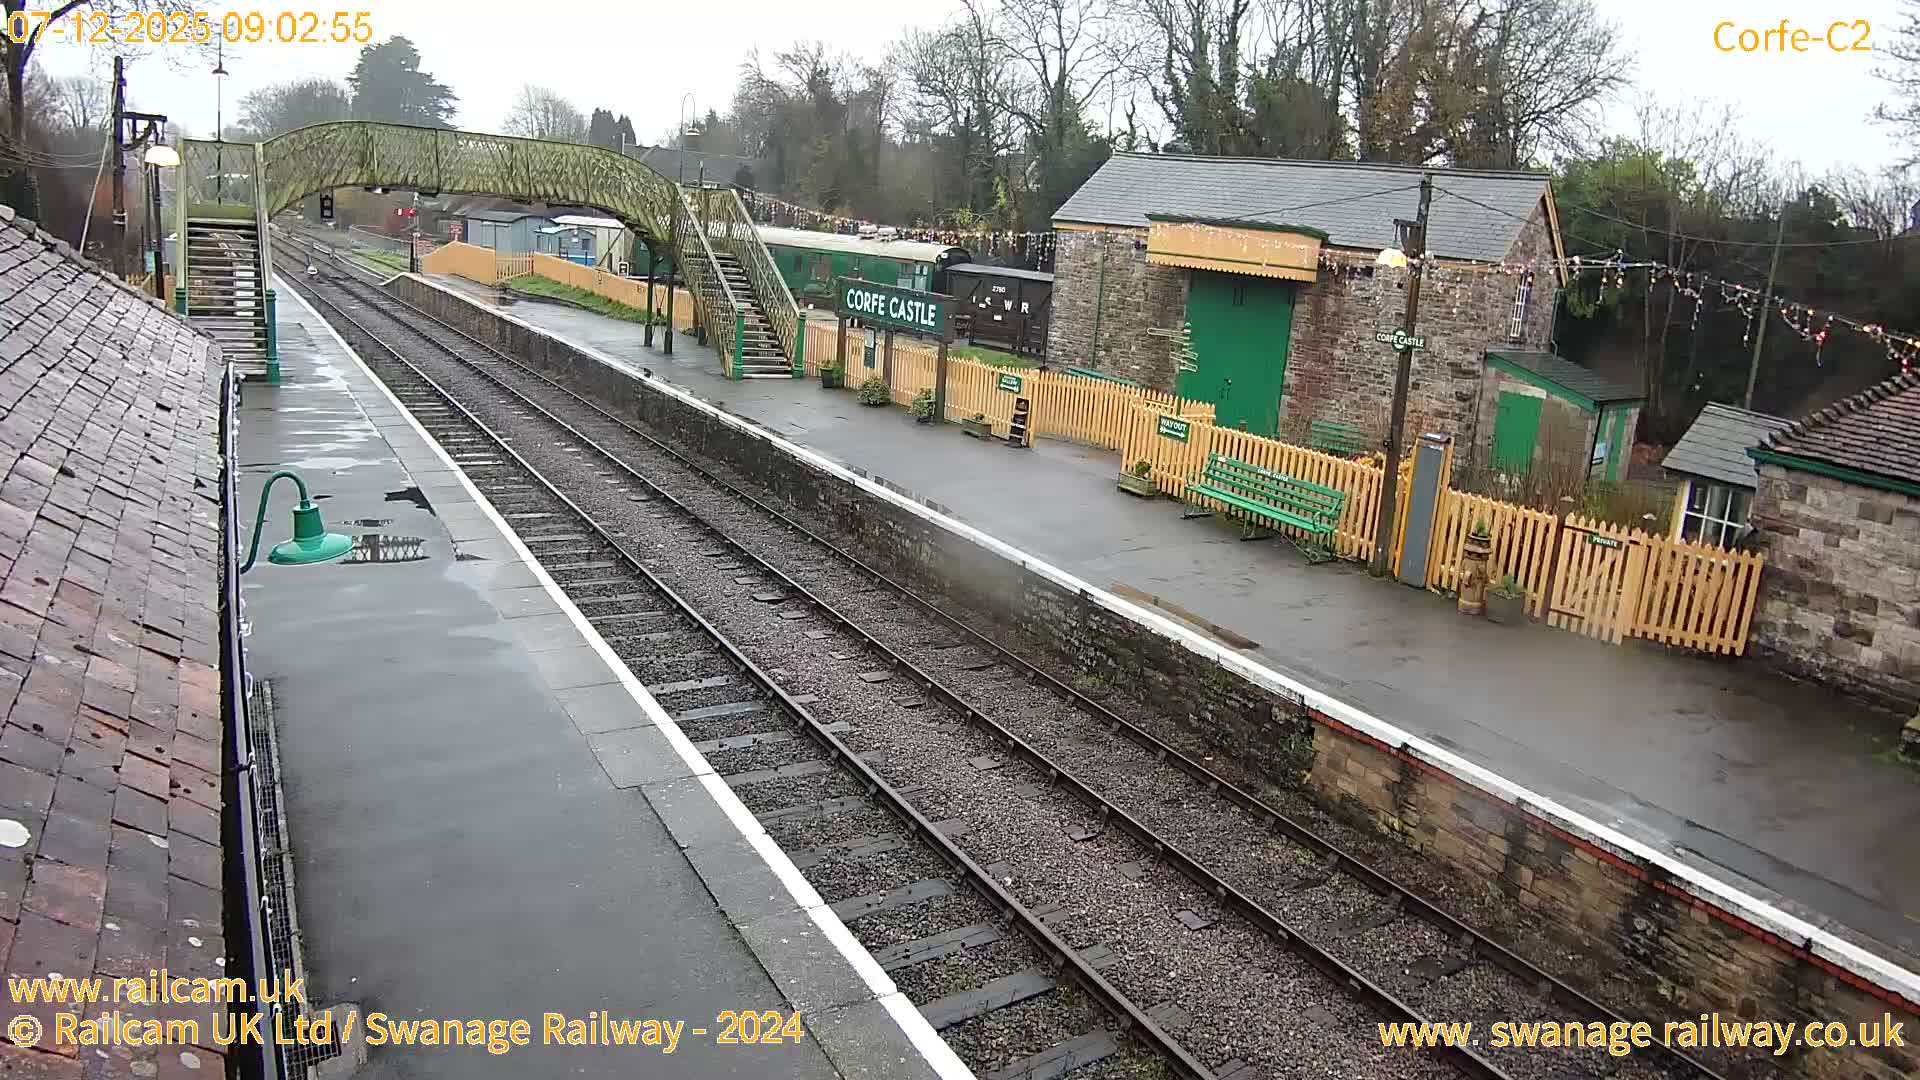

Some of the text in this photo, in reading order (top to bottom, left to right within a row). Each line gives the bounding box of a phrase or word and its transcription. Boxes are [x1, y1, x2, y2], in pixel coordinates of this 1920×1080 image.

[846, 288, 937, 327] CORFE CASTLE
[1376, 332, 1424, 348] CORFE CASTLE
[1160, 418, 1187, 431] WAY OUT
